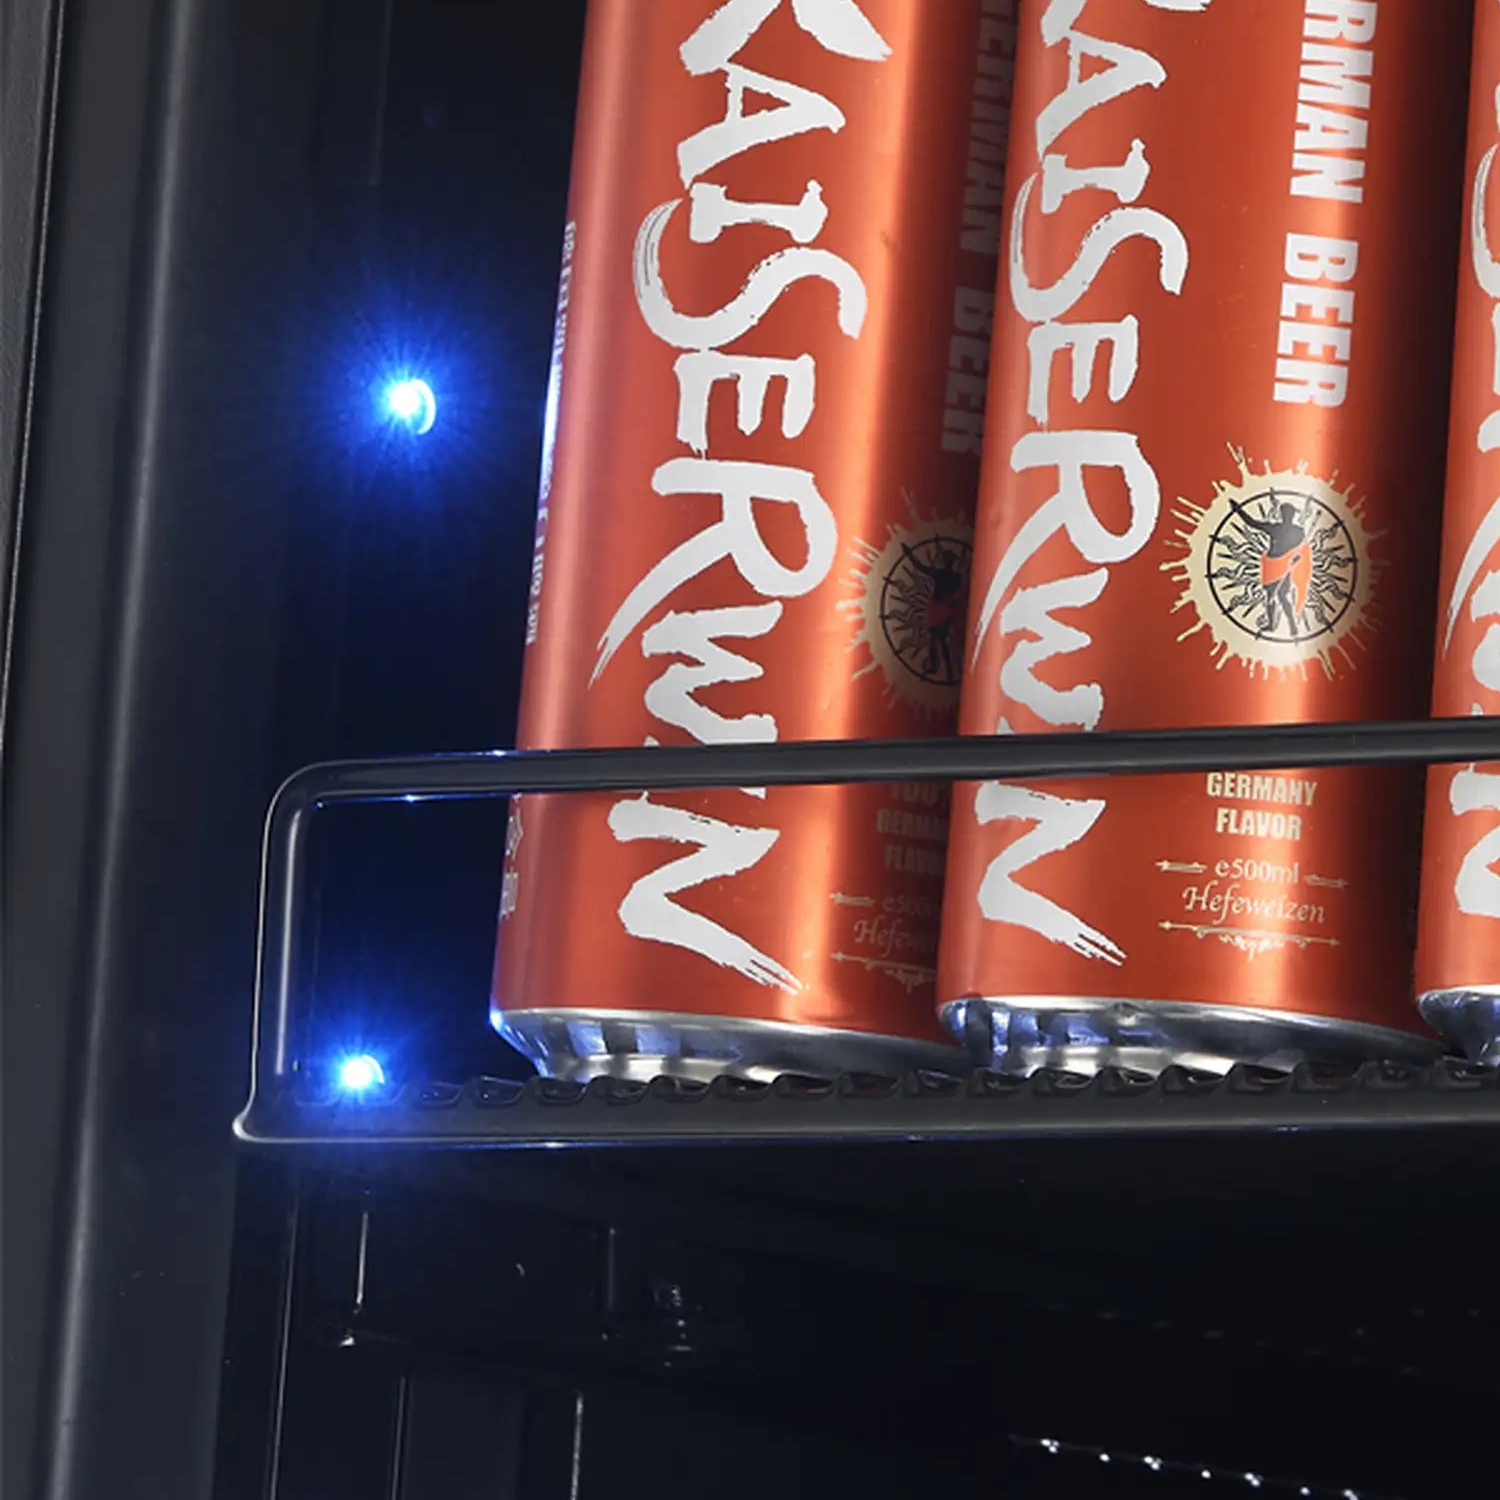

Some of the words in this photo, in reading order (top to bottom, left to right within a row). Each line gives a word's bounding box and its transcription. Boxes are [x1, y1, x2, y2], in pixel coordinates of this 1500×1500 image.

[1273, 232, 1359, 408] BEER
[1206, 771, 1318, 806] GERMANY
[1215, 807, 1302, 840] FLAVOR
[1215, 858, 1299, 885] e500ml
[1182, 880, 1326, 925] Hefeweizen
